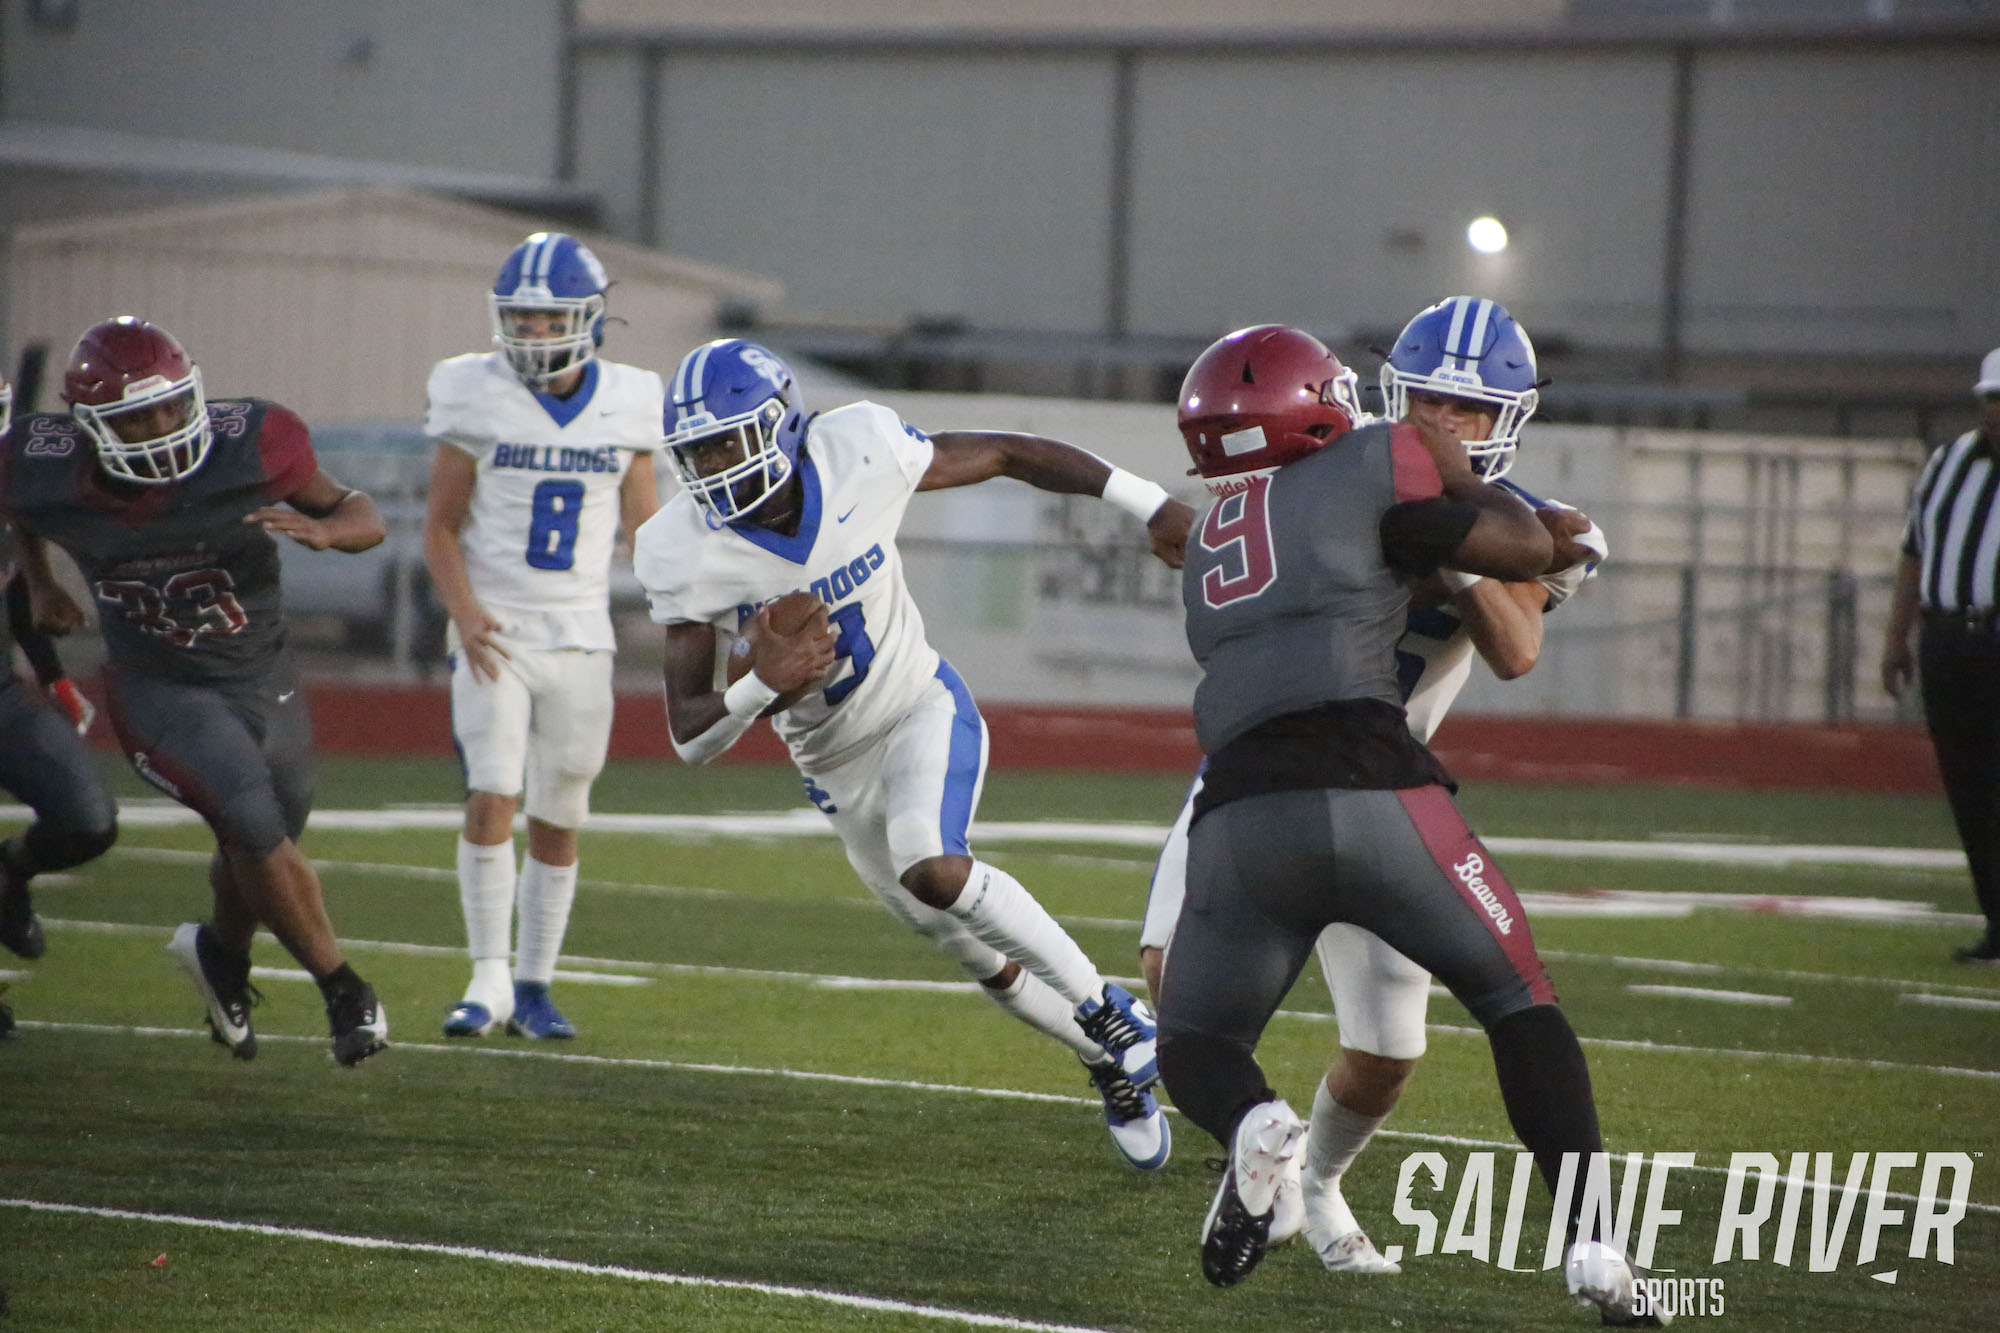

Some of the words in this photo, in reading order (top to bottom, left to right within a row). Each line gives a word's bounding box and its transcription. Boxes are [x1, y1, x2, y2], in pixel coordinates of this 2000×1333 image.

[494, 443, 620, 473] BULLDOGS
[525, 478, 586, 571] 8
[1200, 473, 1277, 610] 9
[1453, 852, 1514, 936] Beavers
